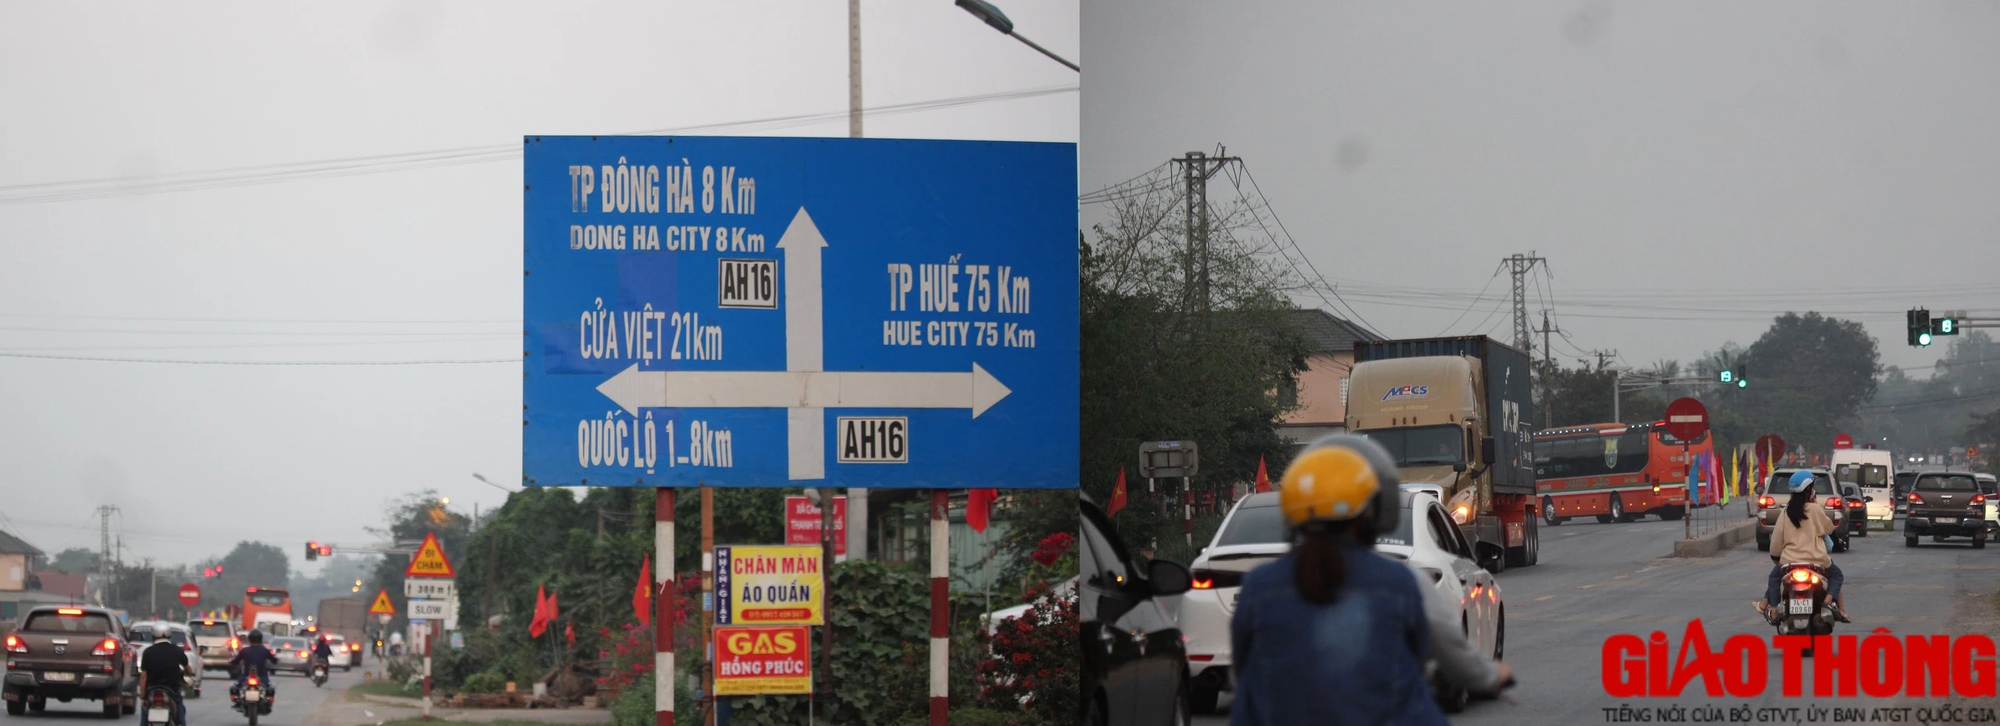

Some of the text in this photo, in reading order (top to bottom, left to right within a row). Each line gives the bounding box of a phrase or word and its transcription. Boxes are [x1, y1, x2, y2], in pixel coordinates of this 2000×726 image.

[569, 156, 756, 215] TP ĐÔNG HÀ 8 Km
[570, 225, 765, 253] DONG HA CITY 8 Km
[887, 253, 1030, 314] TP HUẾ 75 Km
[580, 297, 619, 359] CỬA
[623, 302, 666, 366] VIỆT
[883, 320, 1036, 348] HUE CITY 75 Km
[578, 409, 629, 468] QUỐC
[633, 410, 657, 475] LỘ
[844, 420, 904, 459] AH16
[734, 553, 817, 575] CHĂN MÀN
[742, 583, 762, 603] ÁO
[415, 605, 443, 615] SLOW
[727, 632, 797, 655] GAS
[765, 656, 804, 675] PHÚC
